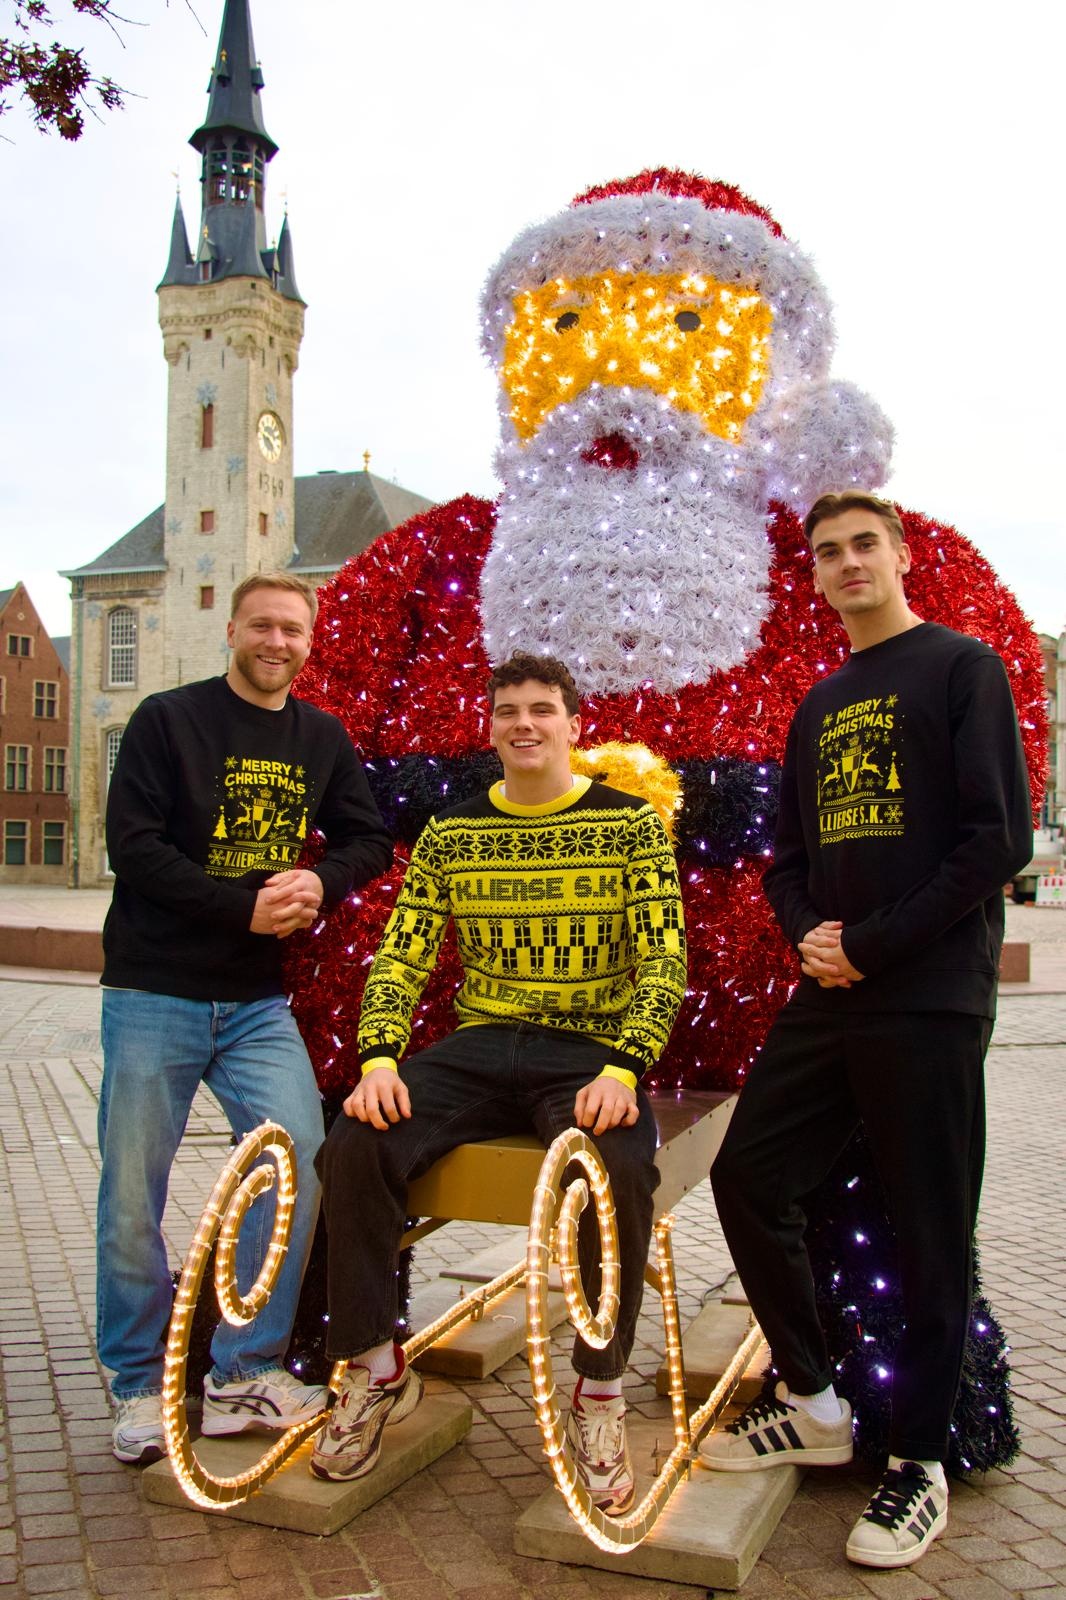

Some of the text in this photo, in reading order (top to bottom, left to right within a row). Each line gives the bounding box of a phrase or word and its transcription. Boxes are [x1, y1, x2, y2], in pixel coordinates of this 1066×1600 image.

[259, 471, 284, 497] 1369
[836, 698, 882, 724] MERRY
[819, 713, 894, 747] CHRISTMAS
[242, 758, 292, 776] MERRY
[225, 772, 306, 794] CHRISTMAS
[859, 805, 884, 824] S.K.
[270, 845, 292, 863] S.K.
